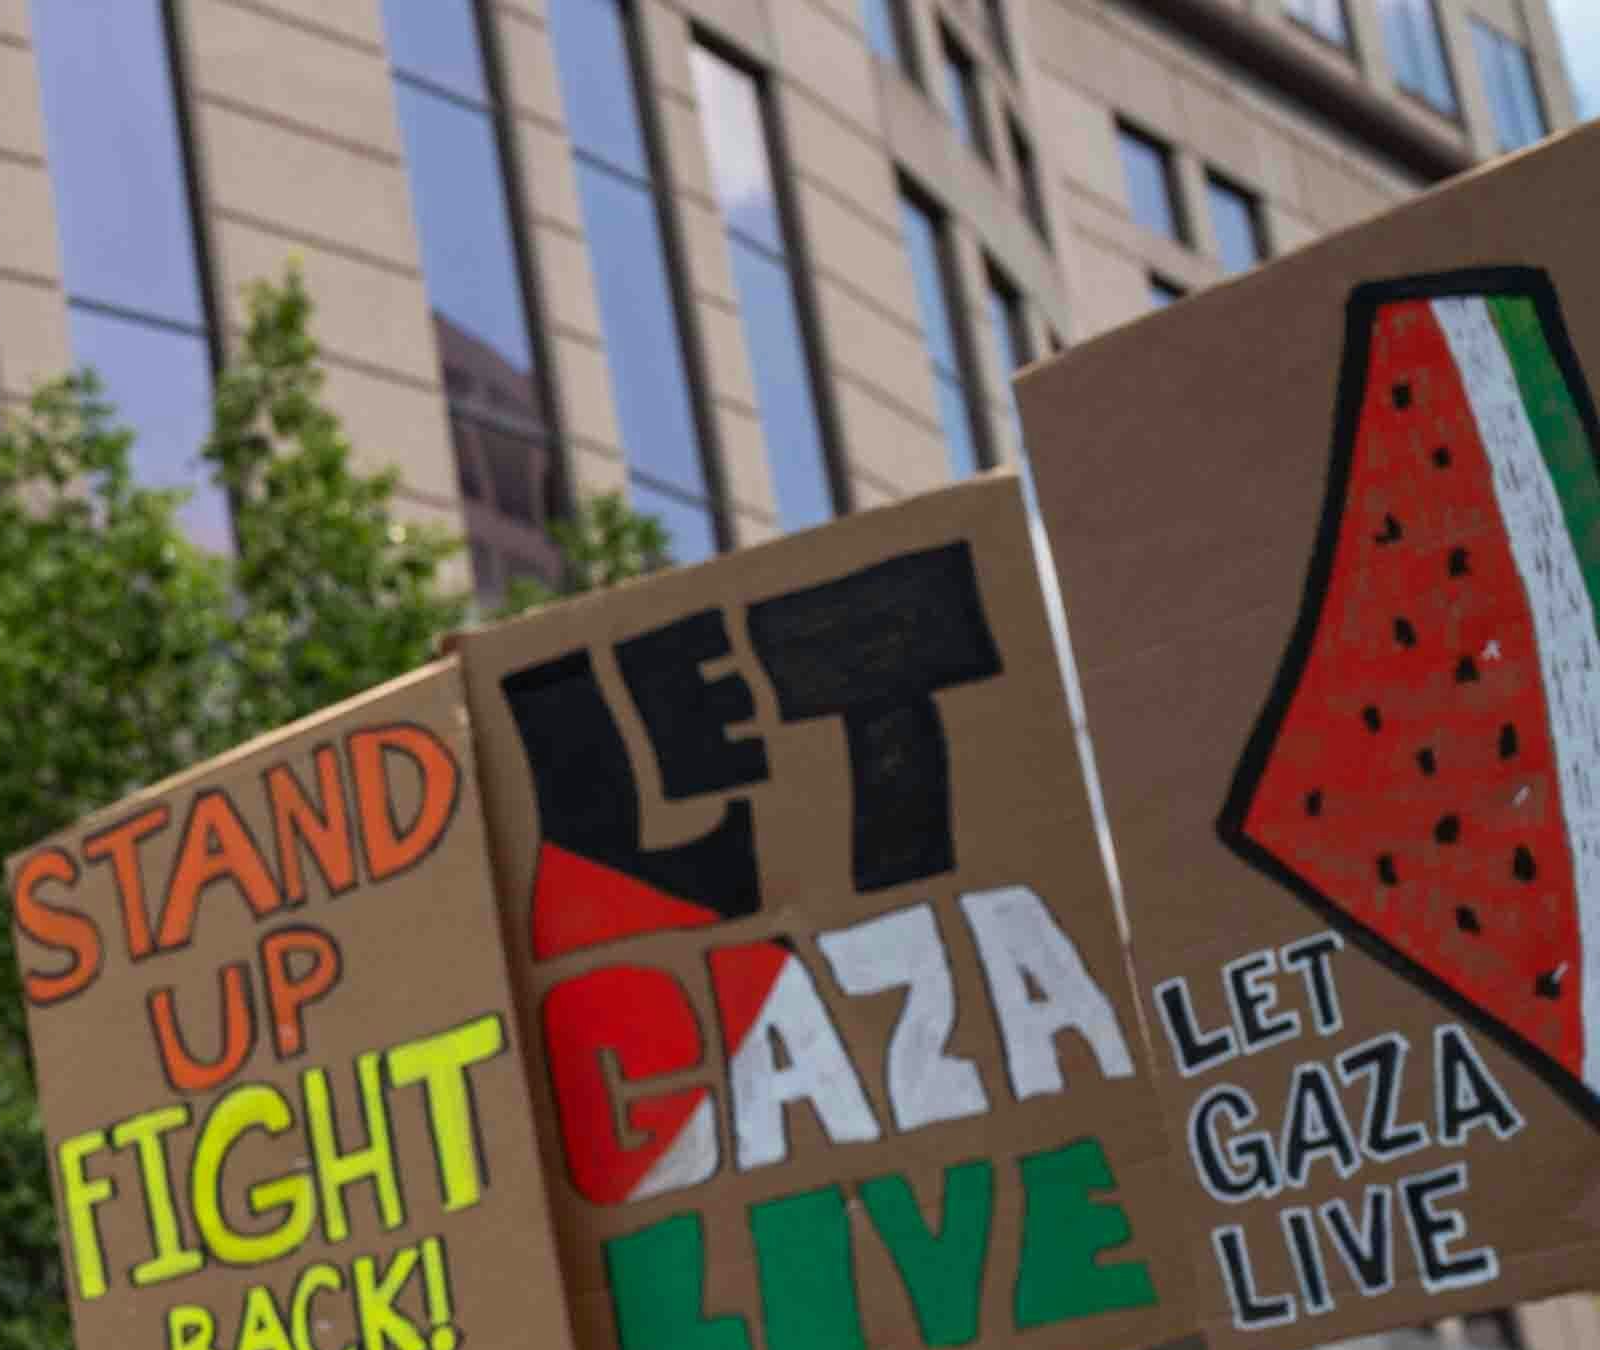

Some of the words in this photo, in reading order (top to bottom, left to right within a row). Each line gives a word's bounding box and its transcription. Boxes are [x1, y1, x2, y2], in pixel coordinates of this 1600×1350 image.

[12, 720, 462, 1007] STAND
[500, 541, 1004, 961] LET
[146, 923, 343, 1094] UP
[544, 884, 1135, 1205] GAZA
[1154, 930, 1344, 1077] LET
[1188, 1024, 1526, 1202] GAZA
[53, 1012, 506, 1303] FIGHT
[1213, 1163, 1498, 1331] LIVE
